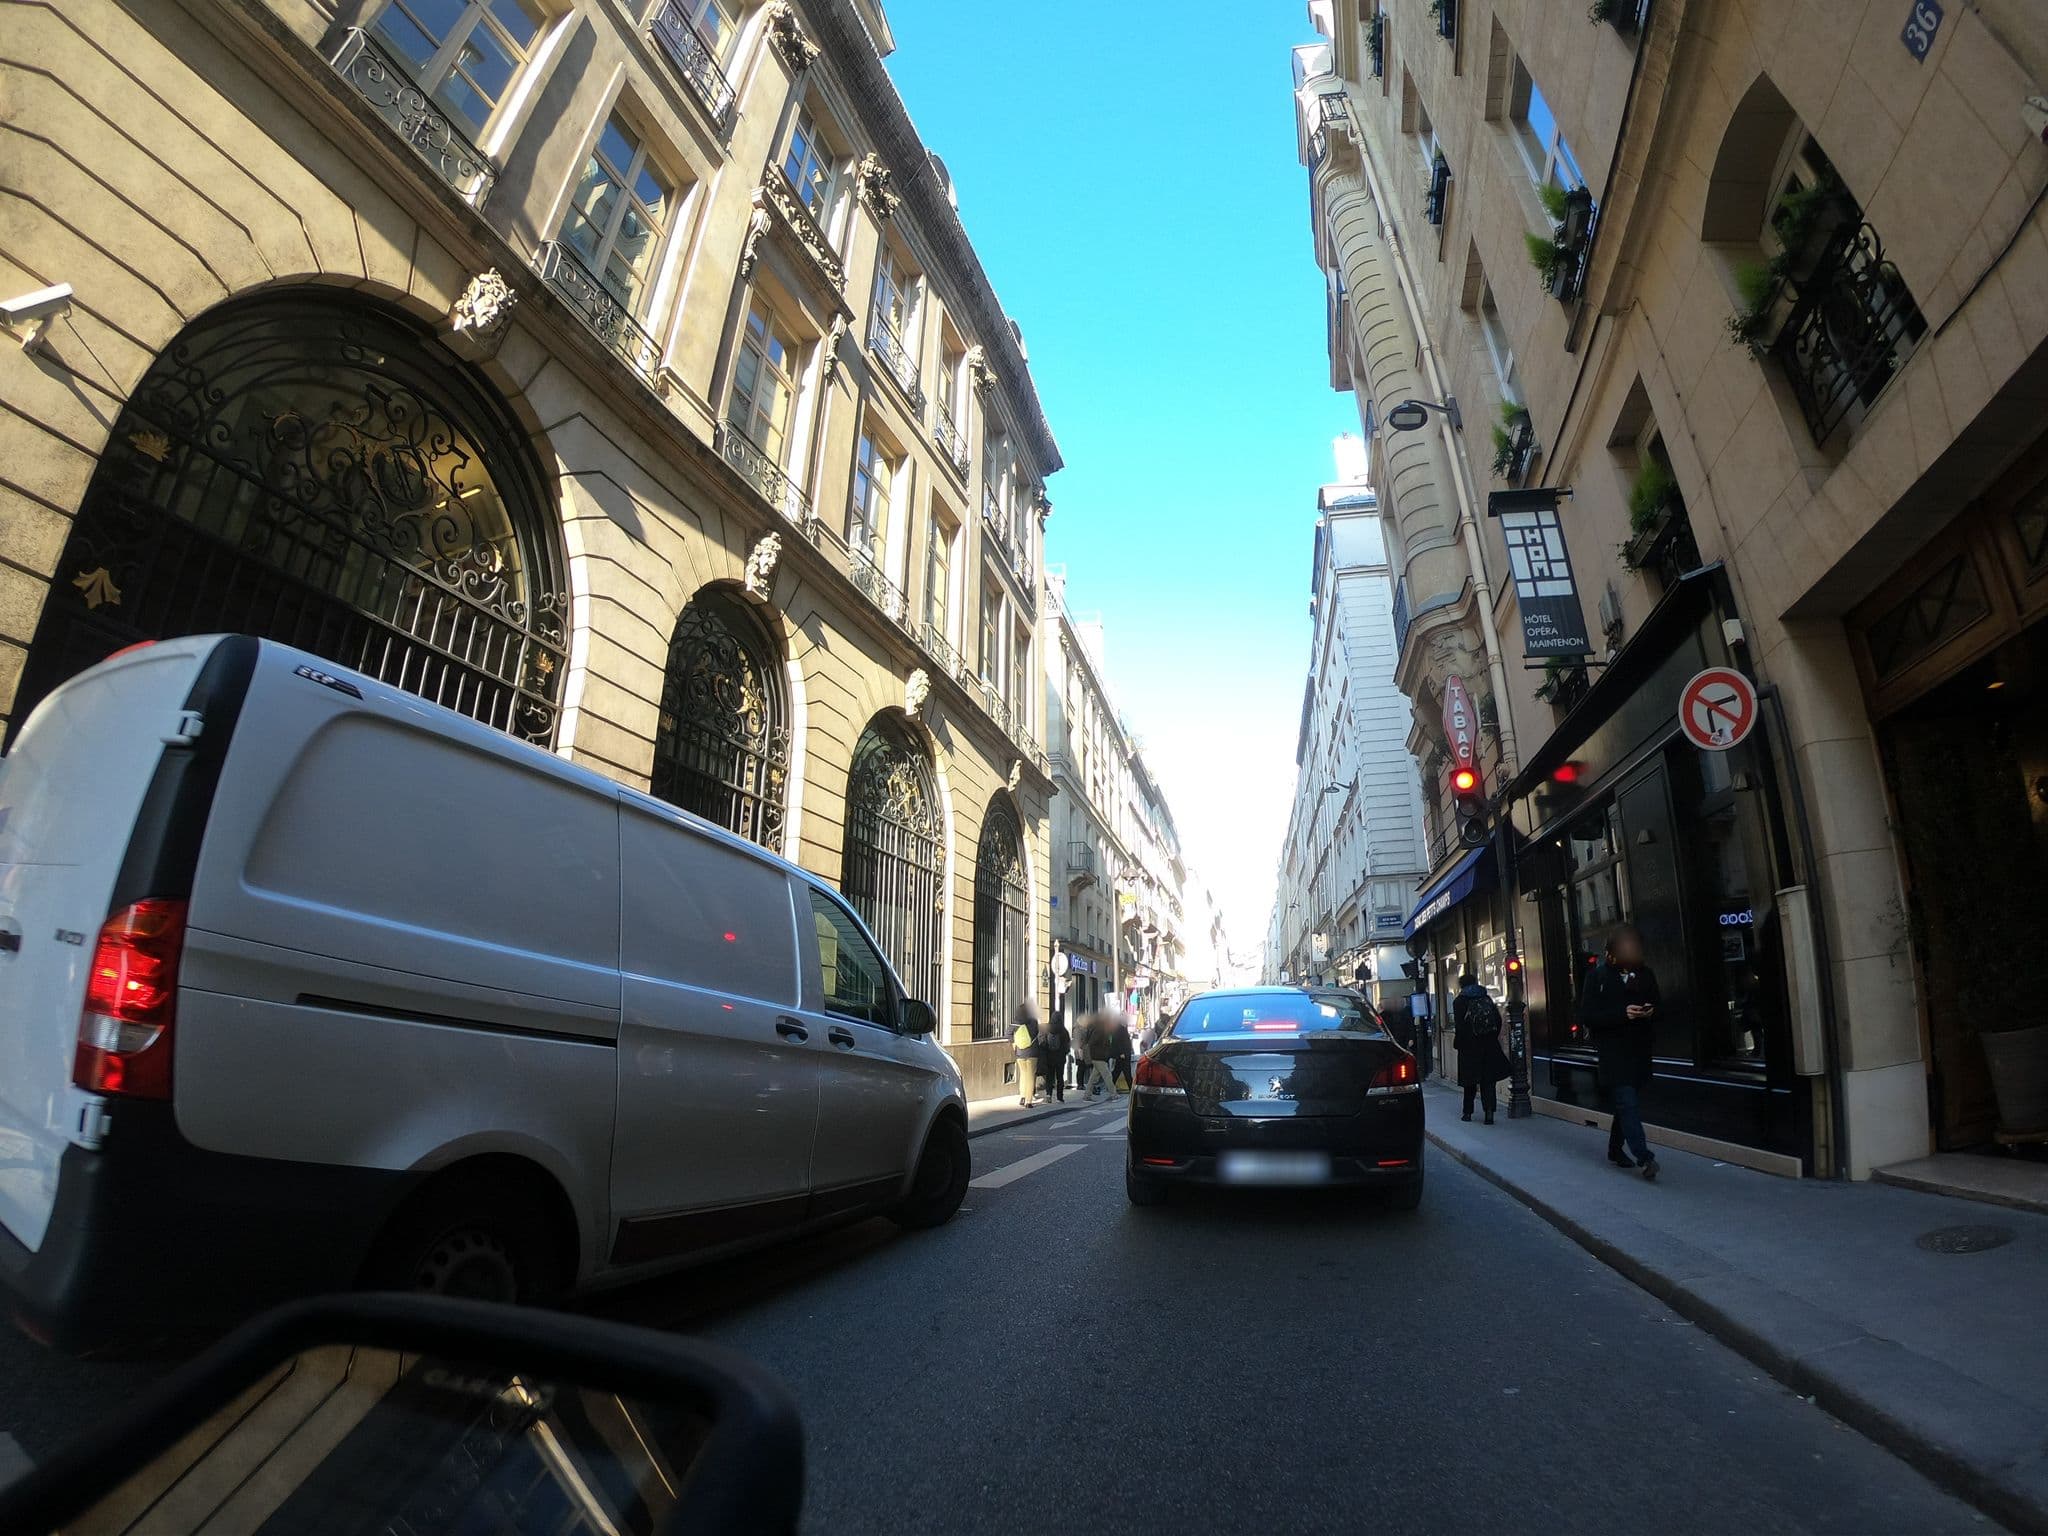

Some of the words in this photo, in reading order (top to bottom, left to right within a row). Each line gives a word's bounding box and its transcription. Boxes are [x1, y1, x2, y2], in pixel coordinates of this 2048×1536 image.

[1907, 2, 1937, 52] 36
[1523, 528, 1551, 578] HOM
[1524, 614, 1553, 624] HÔTEL
[1526, 626, 1559, 637] OPÉRA
[1529, 637, 1585, 648] MAINTENON
[1450, 686, 1470, 758] TABAC
